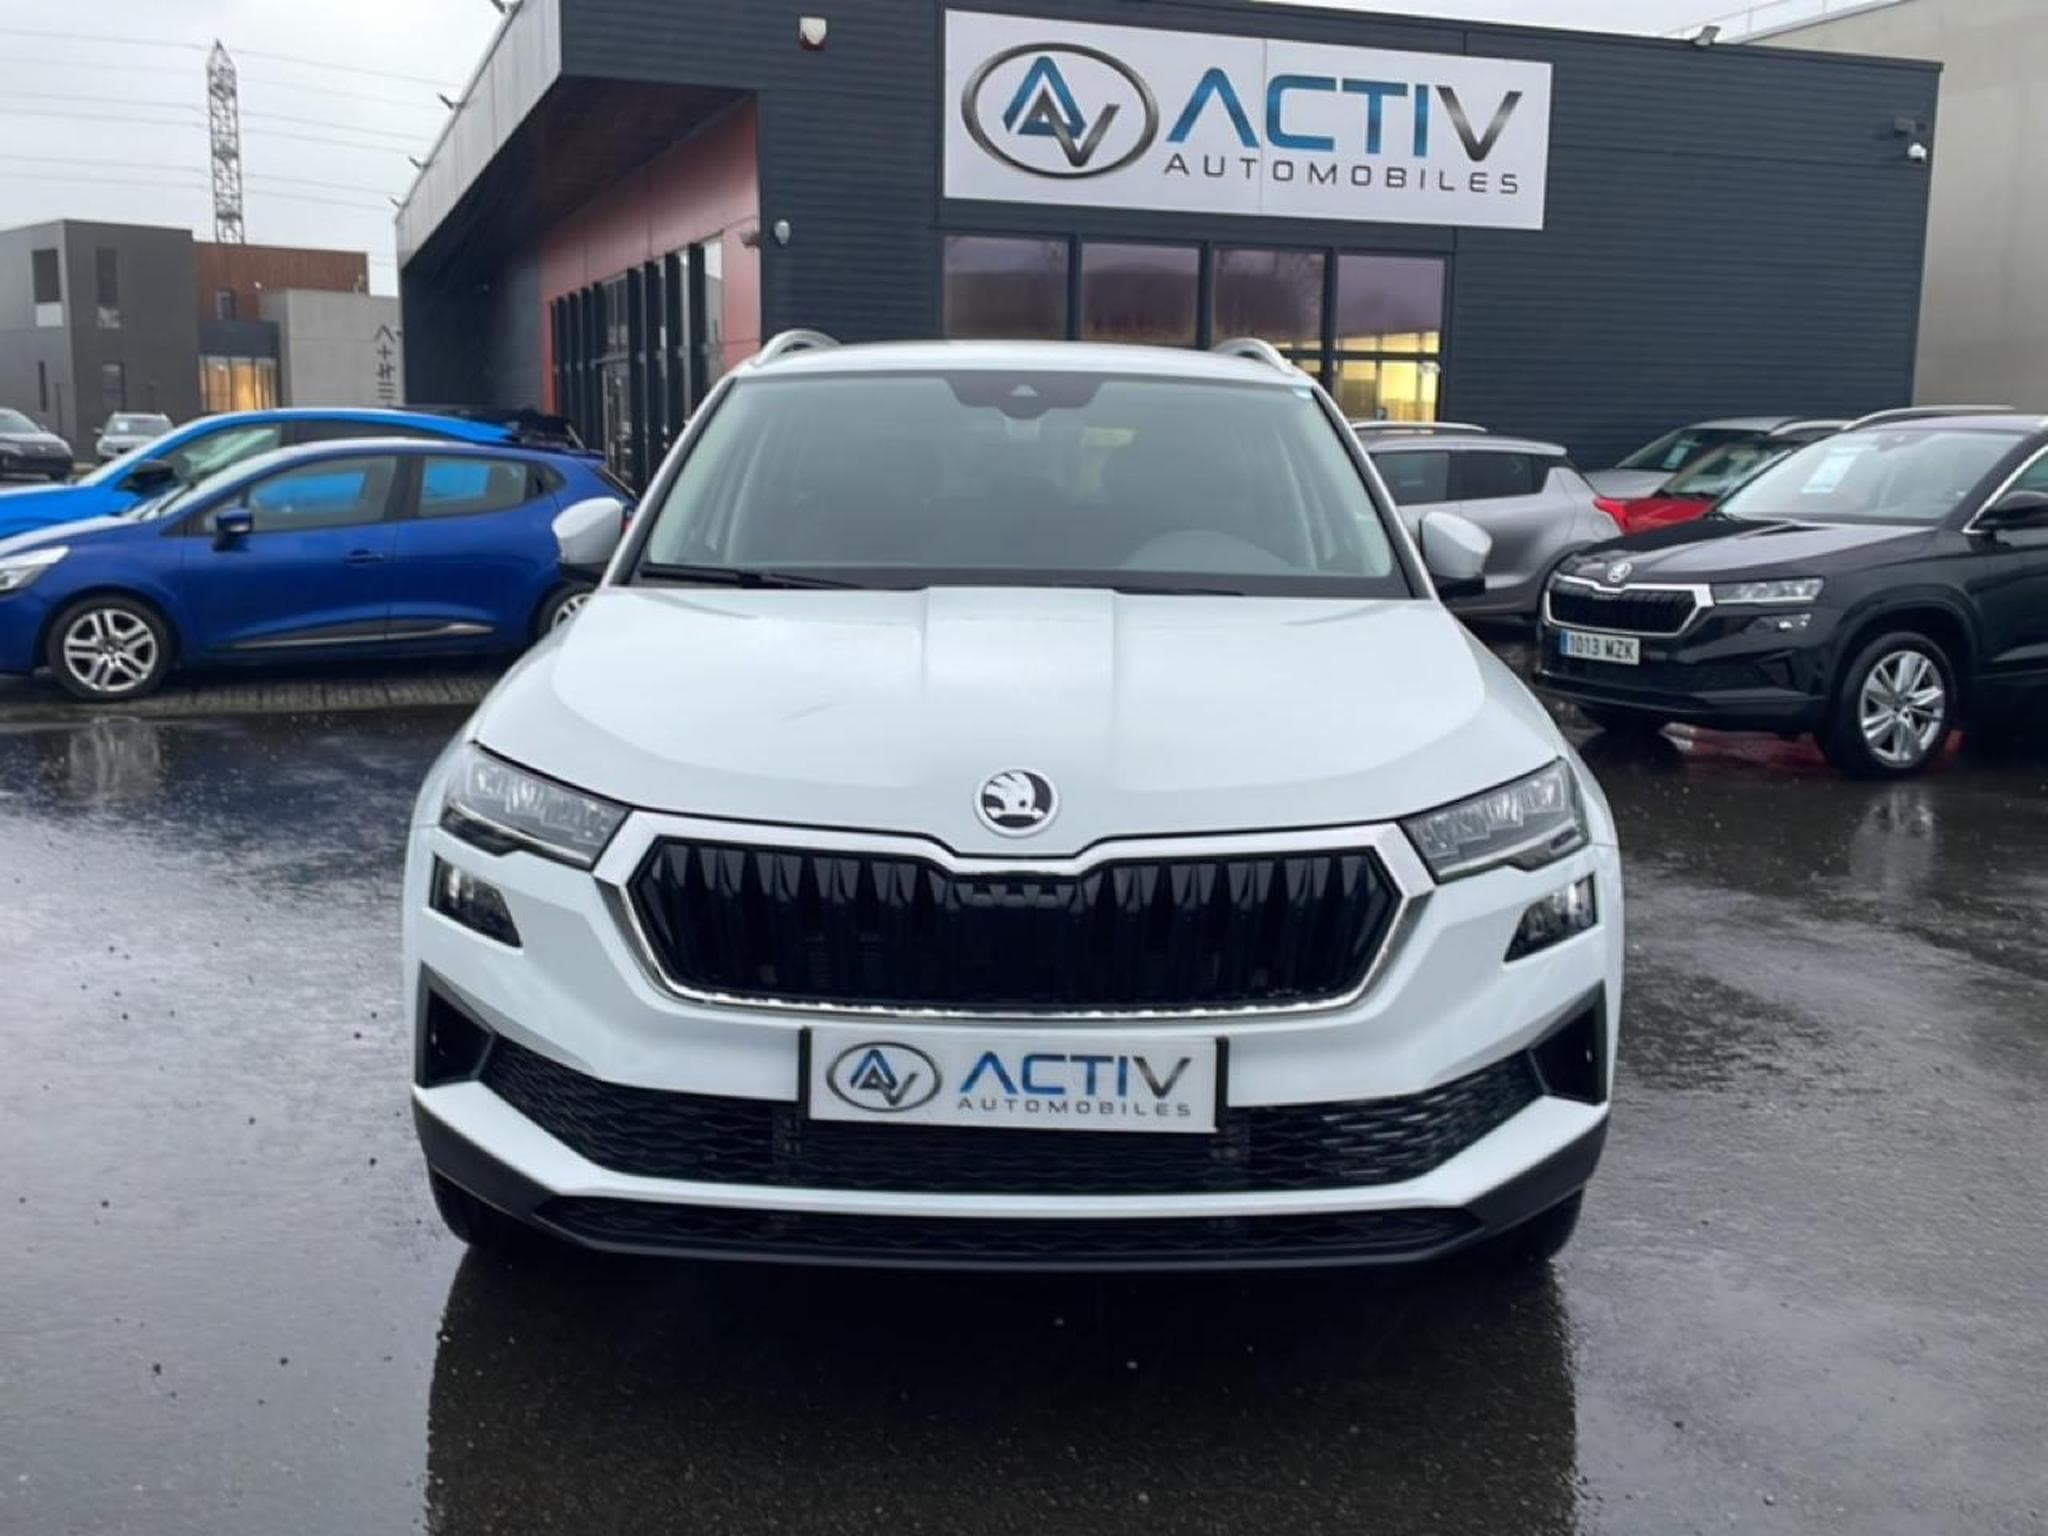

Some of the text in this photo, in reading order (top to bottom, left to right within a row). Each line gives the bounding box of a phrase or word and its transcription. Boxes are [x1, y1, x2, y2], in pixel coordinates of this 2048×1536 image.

[1166, 66, 1523, 163] ACTIV
[1164, 152, 1519, 195] AUTOMOBILES
[1569, 632, 1599, 655] 1013
[959, 1051, 1192, 1099] ACTIV
[957, 1098, 1192, 1117] AUTOMOBILES
